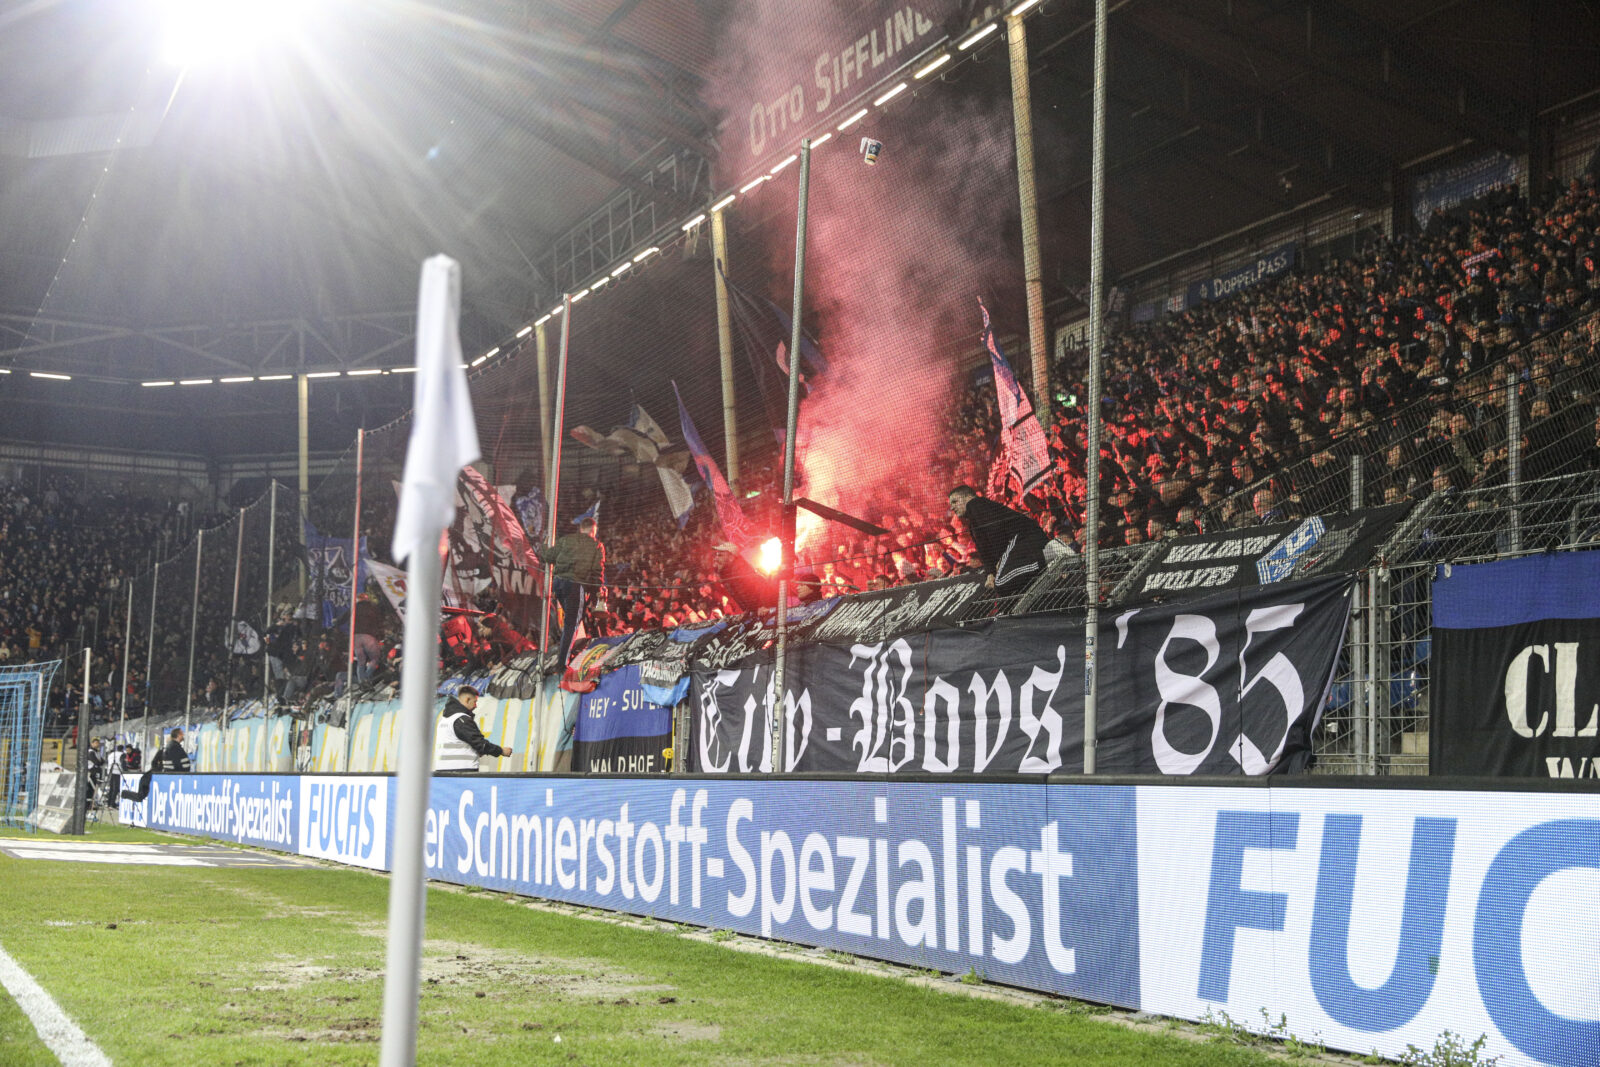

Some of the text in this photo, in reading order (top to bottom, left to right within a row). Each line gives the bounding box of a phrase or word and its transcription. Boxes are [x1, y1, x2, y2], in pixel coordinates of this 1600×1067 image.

[750, 84, 804, 155] OTTO
[1141, 564, 1239, 592] WOLVES
[1161, 533, 1281, 564] WALDHOF
[1114, 603, 1305, 775] '85
[151, 781, 168, 824] Der
[168, 778, 293, 844] Schmierstoff-Spezialist
[307, 783, 377, 860] FUCHS
[424, 786, 1077, 975] er Schmierstoff-Spezialist
